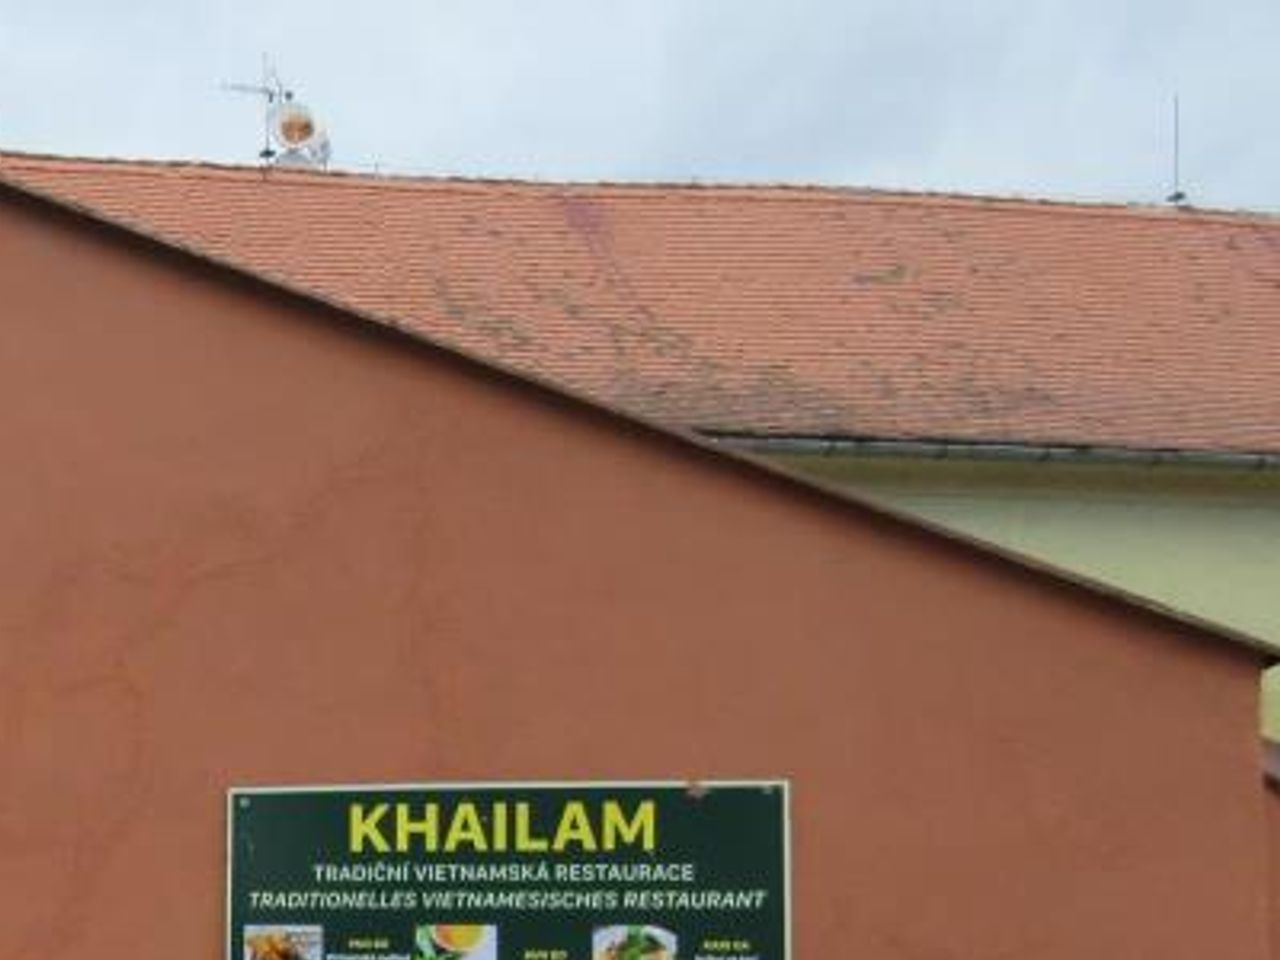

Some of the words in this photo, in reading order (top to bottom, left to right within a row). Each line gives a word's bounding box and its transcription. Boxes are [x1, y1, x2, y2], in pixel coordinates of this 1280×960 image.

[349, 803, 656, 853] KHAILAM
[313, 861, 410, 882] TRADIČNÍ
[413, 861, 550, 882] VIETNAMSKÁ
[555, 863, 694, 882] RESTAURACE
[249, 891, 418, 910] TRADITIONELLES
[422, 890, 619, 910] VIETNAMESISCHES
[623, 889, 768, 909] RESTAURANT
